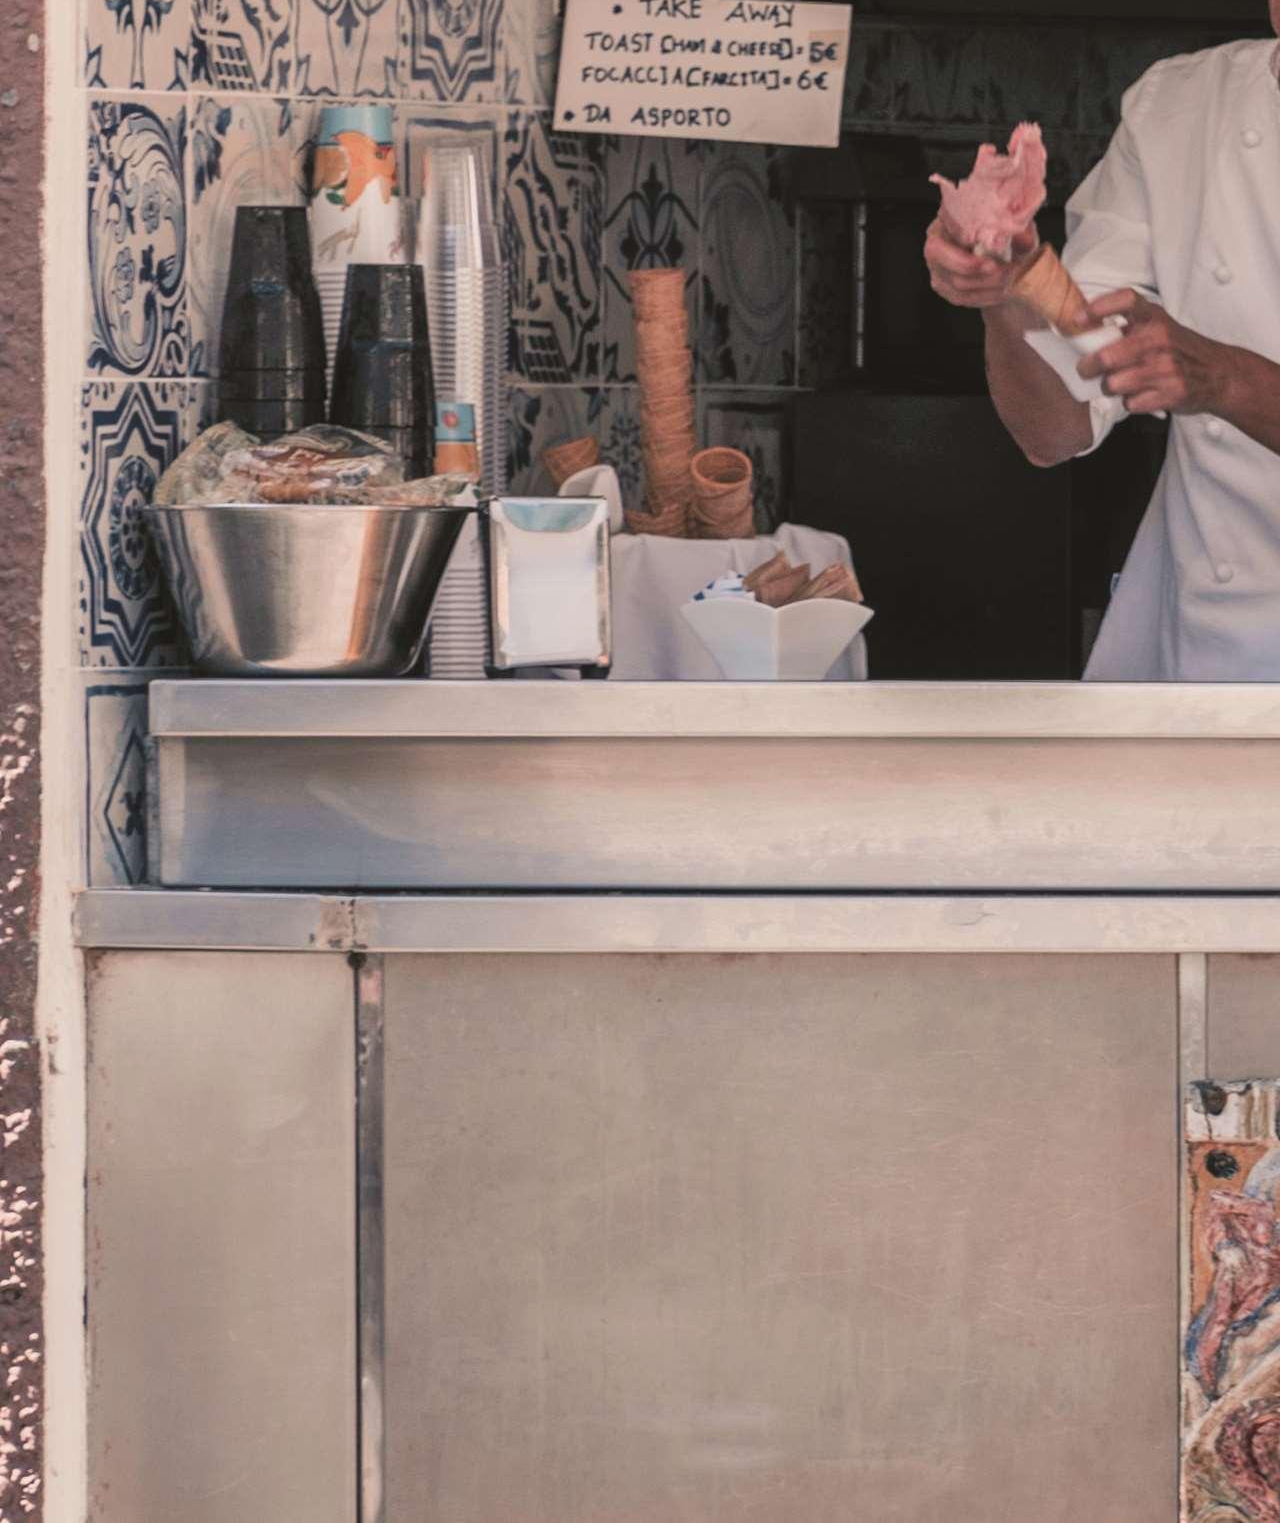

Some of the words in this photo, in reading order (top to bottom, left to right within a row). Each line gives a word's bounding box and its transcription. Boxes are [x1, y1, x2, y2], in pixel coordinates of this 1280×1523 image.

[725, 2, 795, 27] AWAY
[584, 32, 653, 53] TOAST
[809, 42, 838, 63] 5€
[797, 70, 828, 91] 6€
[584, 104, 611, 124] DA
[630, 107, 731, 127] ASPORTO
